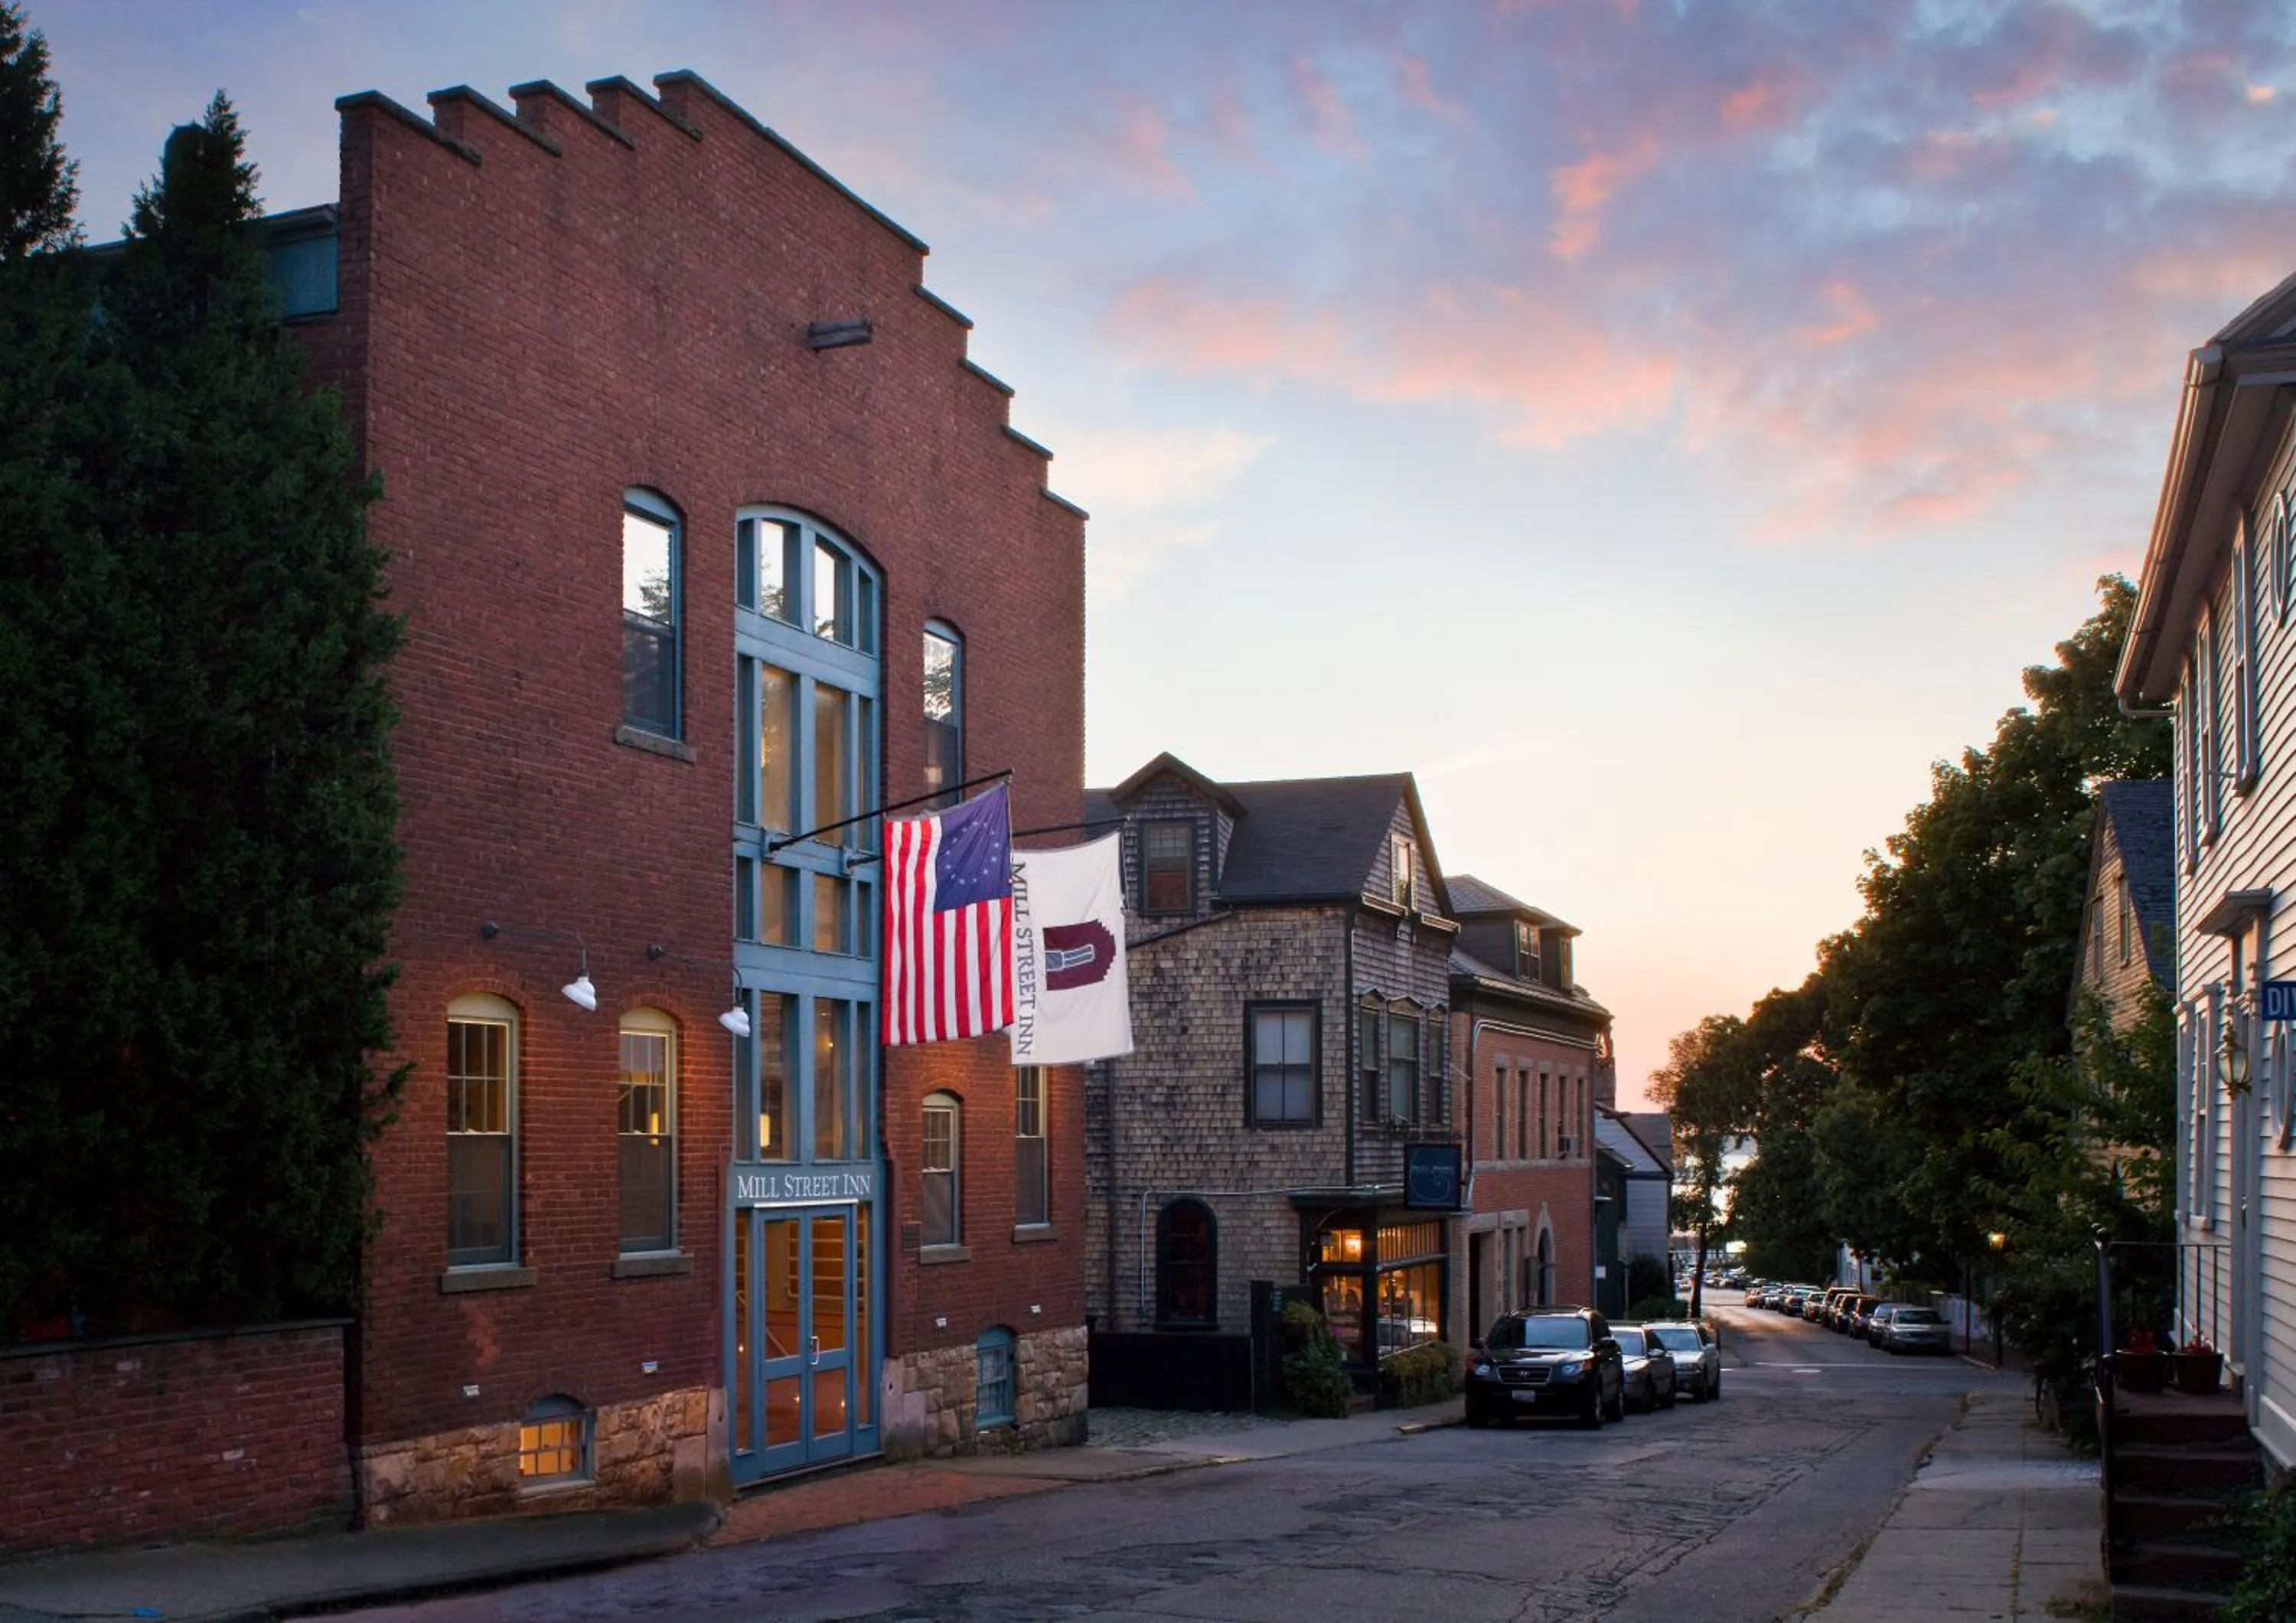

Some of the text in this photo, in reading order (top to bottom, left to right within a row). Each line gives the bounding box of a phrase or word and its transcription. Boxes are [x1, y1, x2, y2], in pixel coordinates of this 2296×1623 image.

[1010, 862, 1036, 1056] MILL STREET INN
[737, 1173, 872, 1198] MILL STREET INN
